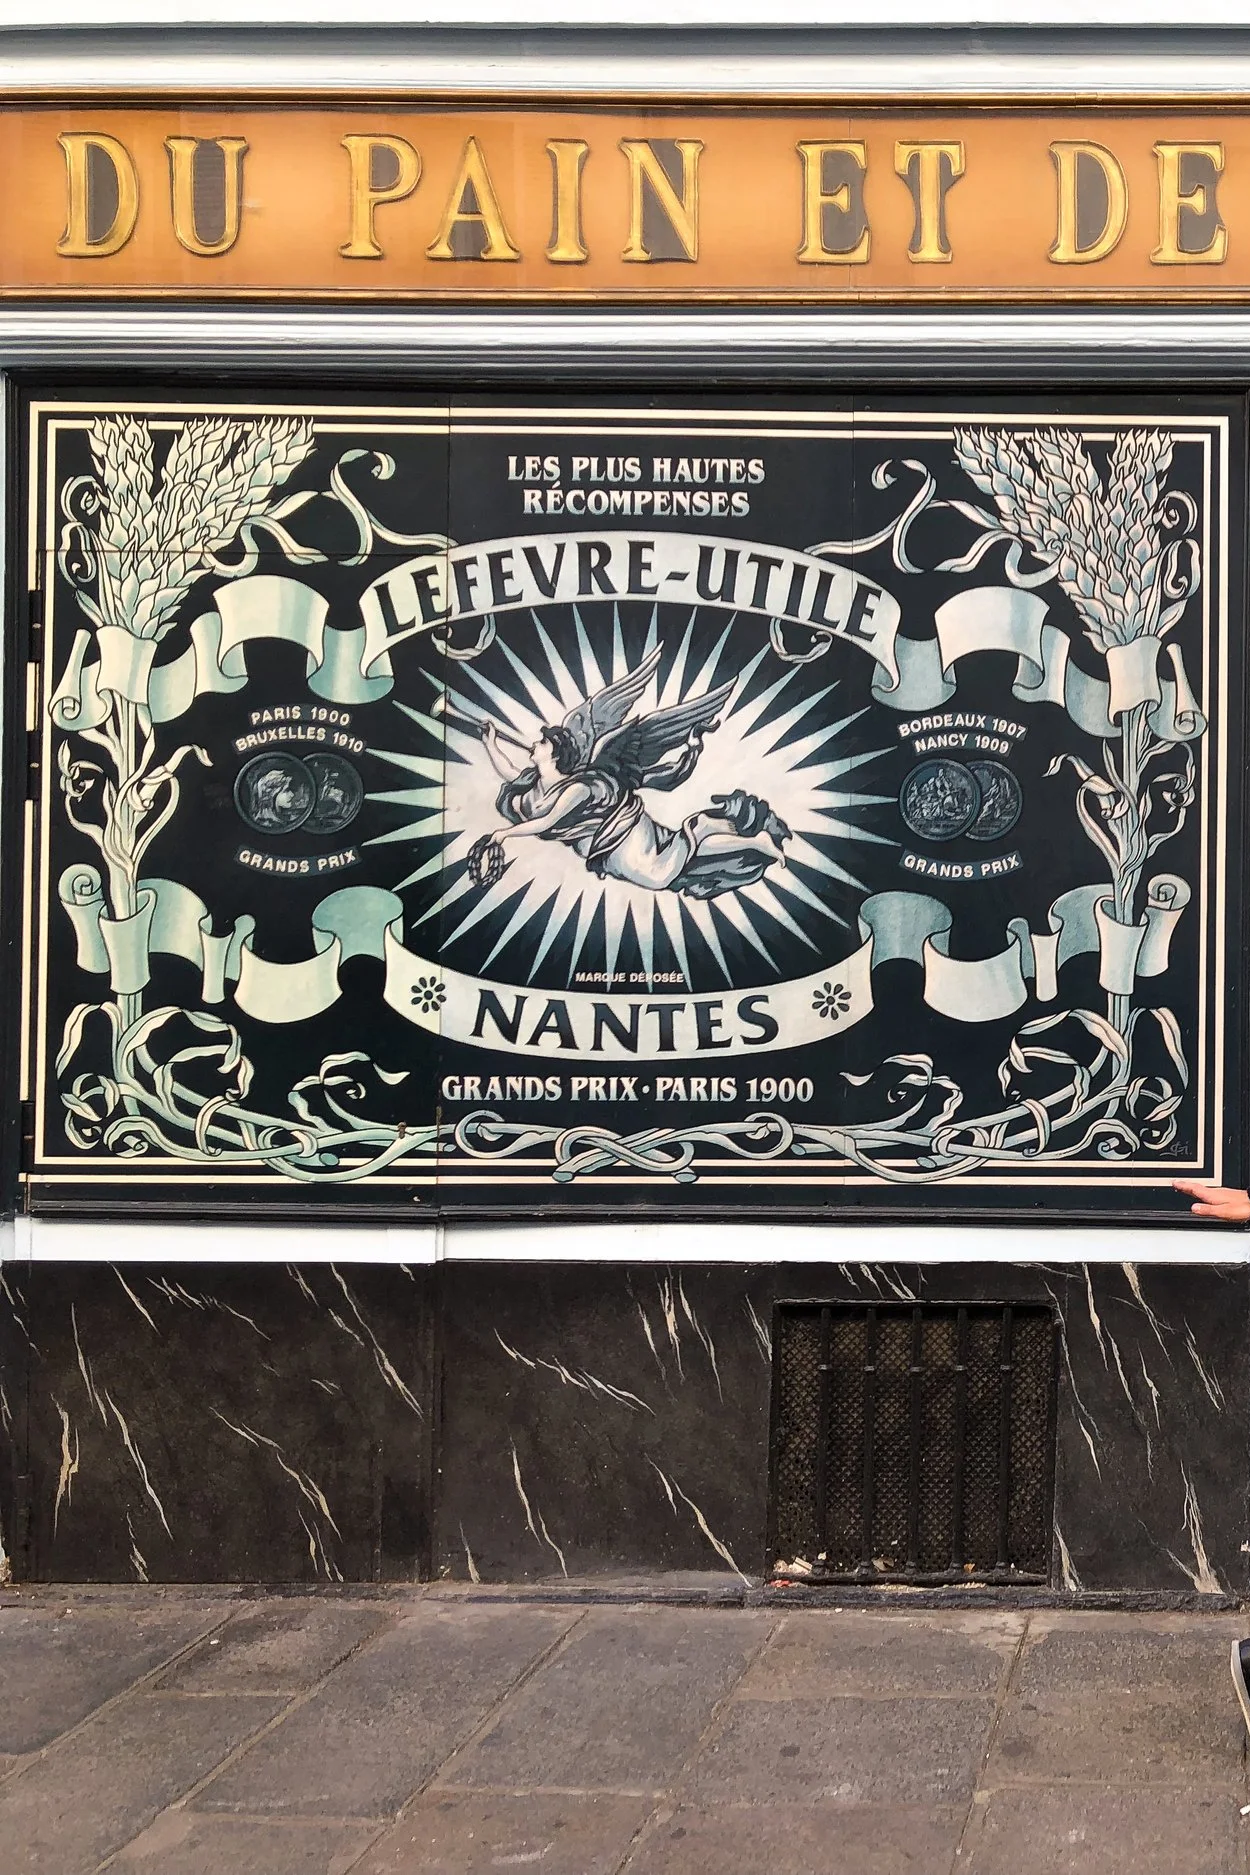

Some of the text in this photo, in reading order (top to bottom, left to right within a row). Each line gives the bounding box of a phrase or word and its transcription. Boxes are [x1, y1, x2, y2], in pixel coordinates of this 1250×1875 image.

[56, 131, 250, 259] DU
[338, 133, 705, 264] PAIN
[796, 139, 966, 267] ET
[508, 456, 766, 484] LES PLUS HAUTES
[523, 481, 750, 517] RÉCOMPENSES
[373, 540, 884, 644] LEFEVRE-UTILE
[251, 705, 350, 726] PARIS 1900
[898, 713, 1026, 739] BORDEAUX 1907
[235, 726, 364, 753] BRUXELLES 1910
[914, 733, 1009, 754] NANCY 1909
[239, 849, 356, 874] GRANDS PRIX
[904, 854, 1020, 878] GRANDS PRIX
[575, 970, 684, 984] MARQUE DÉPOSÉE
[470, 988, 780, 1054] NANTES
[441, 1075, 814, 1103] GRANDS PRIX PARIS 1900
